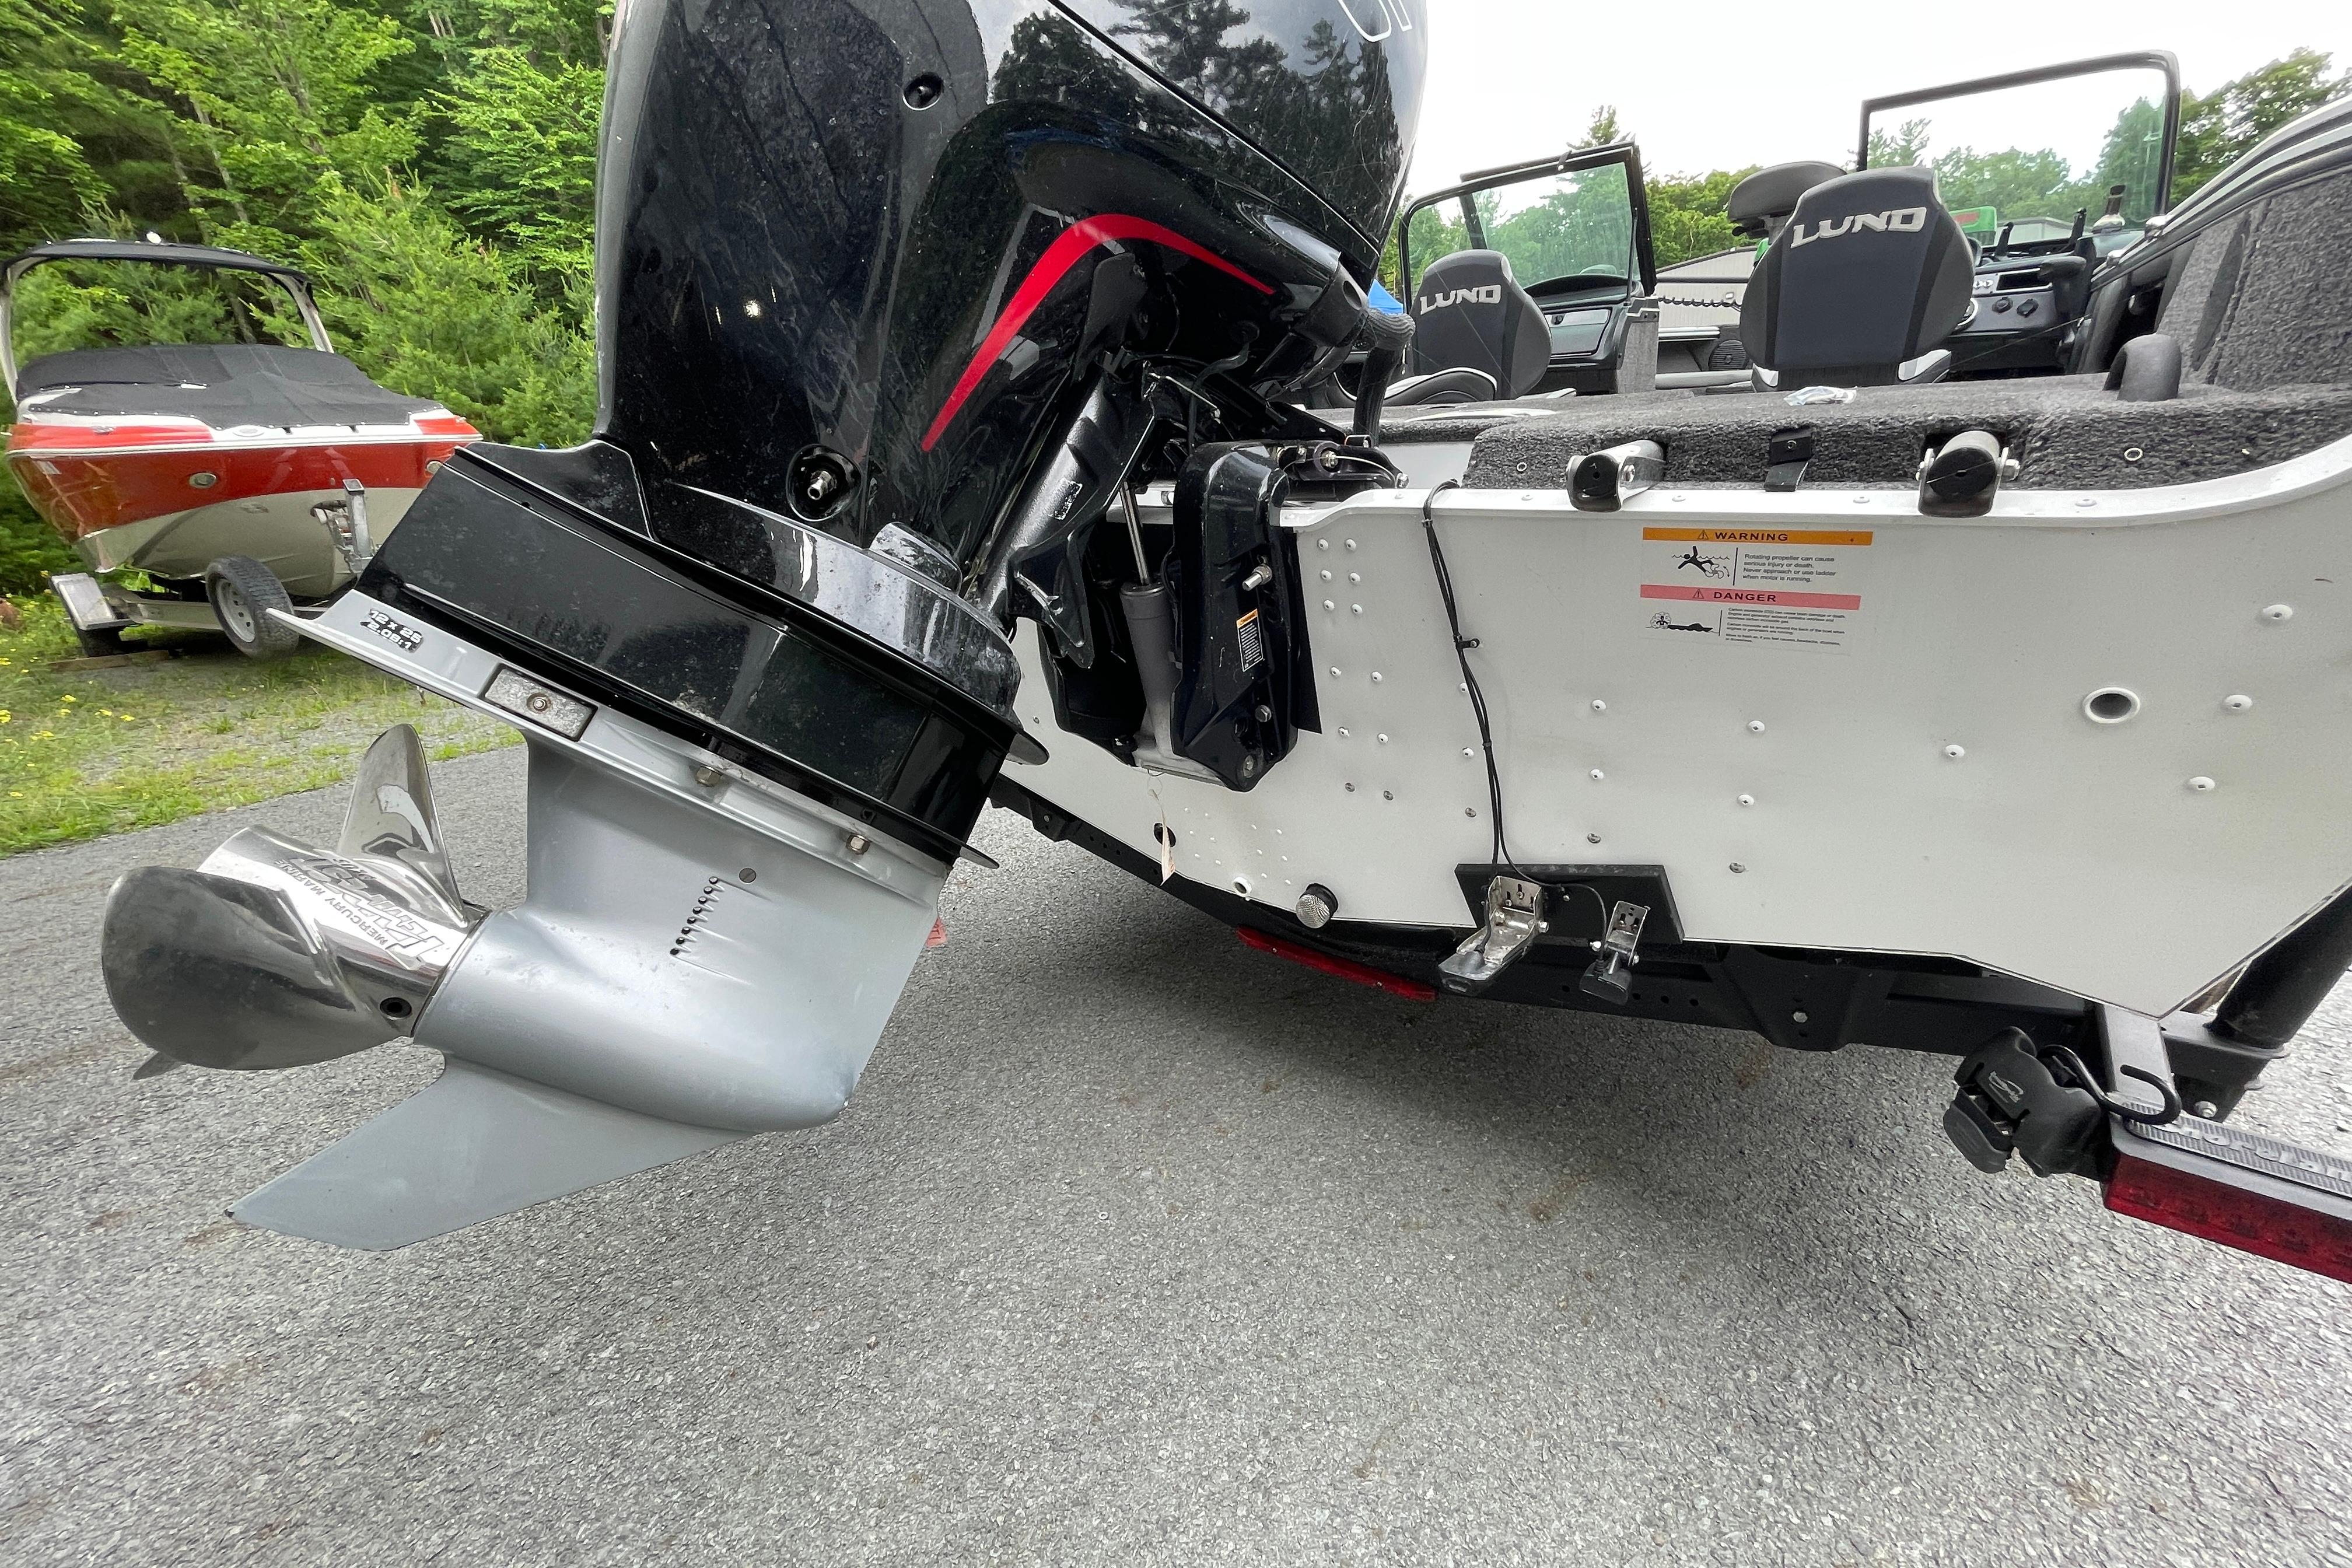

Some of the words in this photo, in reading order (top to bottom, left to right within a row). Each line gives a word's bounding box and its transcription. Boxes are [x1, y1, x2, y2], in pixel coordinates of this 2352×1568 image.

[1790, 207, 1927, 249] LUND
[1420, 284, 1502, 315] LUND
[1715, 532, 1788, 541] WARNING
[1714, 592, 1776, 602] DANGER
[370, 610, 389, 625] 12
[274, 859, 326, 896] MARINE
[324, 897, 388, 946] MERCURY
